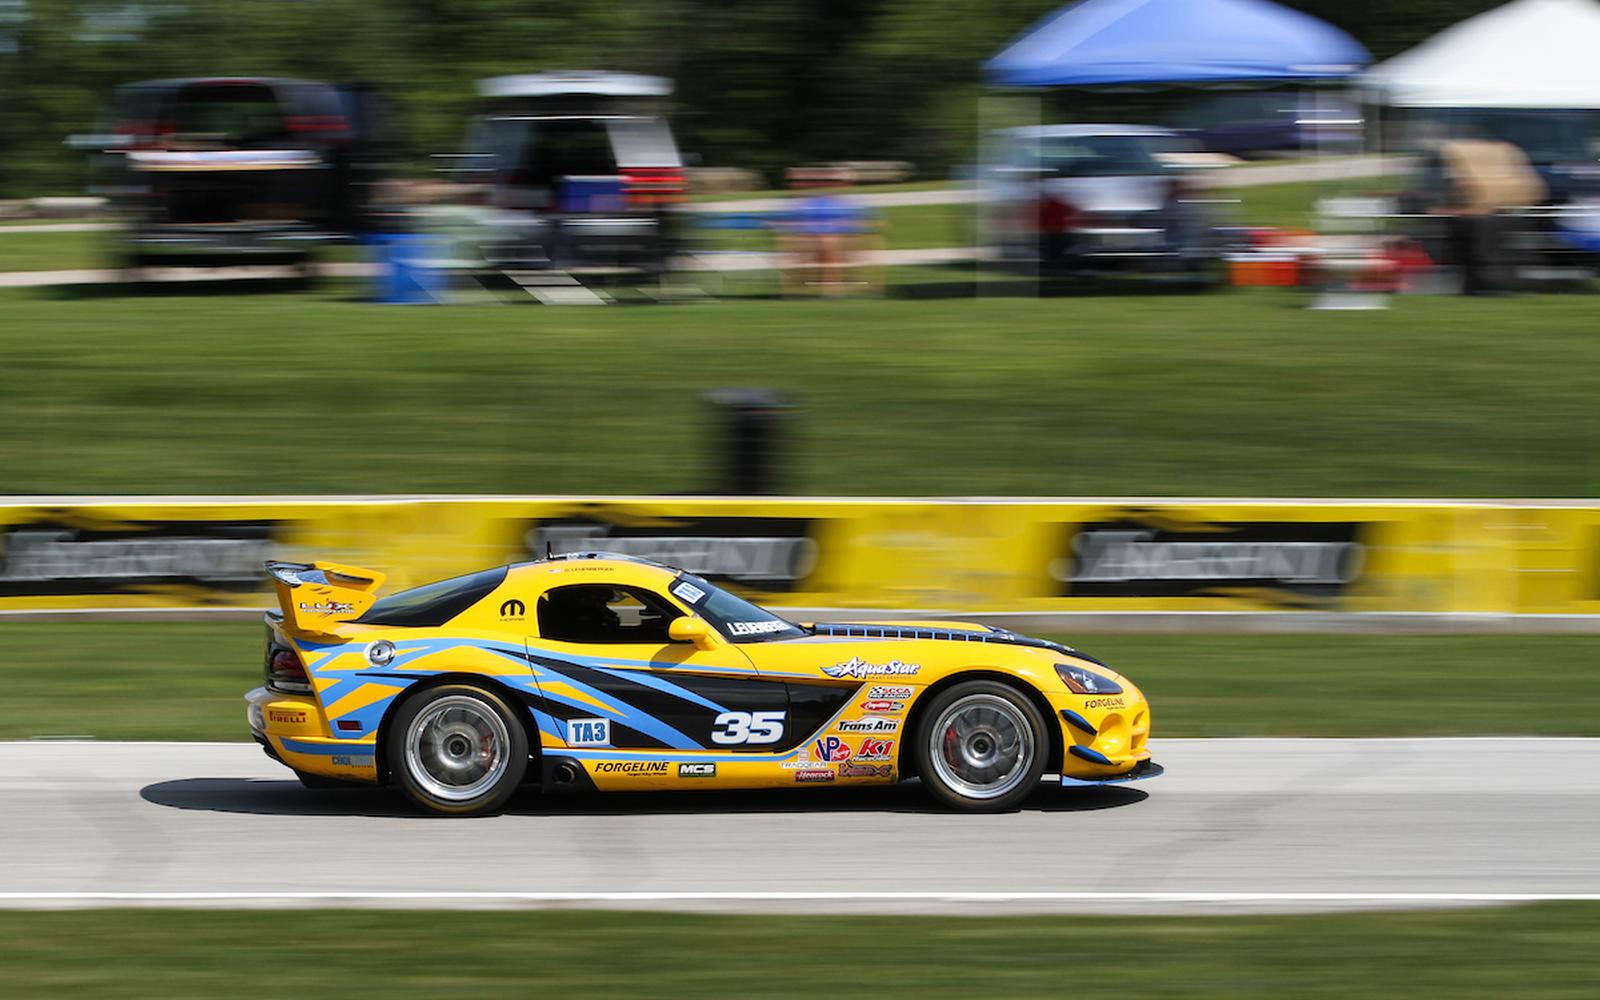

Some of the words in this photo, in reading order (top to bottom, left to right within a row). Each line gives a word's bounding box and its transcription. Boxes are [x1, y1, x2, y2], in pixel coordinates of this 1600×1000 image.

[836, 656, 920, 679] AquaStar
[1085, 697, 1125, 710] FORGELINE
[269, 710, 306, 723] PIRELLI
[572, 722, 606, 743] TA3
[711, 711, 787, 745] 35
[838, 721, 873, 731] Trans
[874, 720, 897, 730] Am
[816, 737, 841, 762] VP
[858, 739, 894, 756] K1
[594, 762, 670, 773] FORGELINE
[679, 764, 715, 774] MCS
